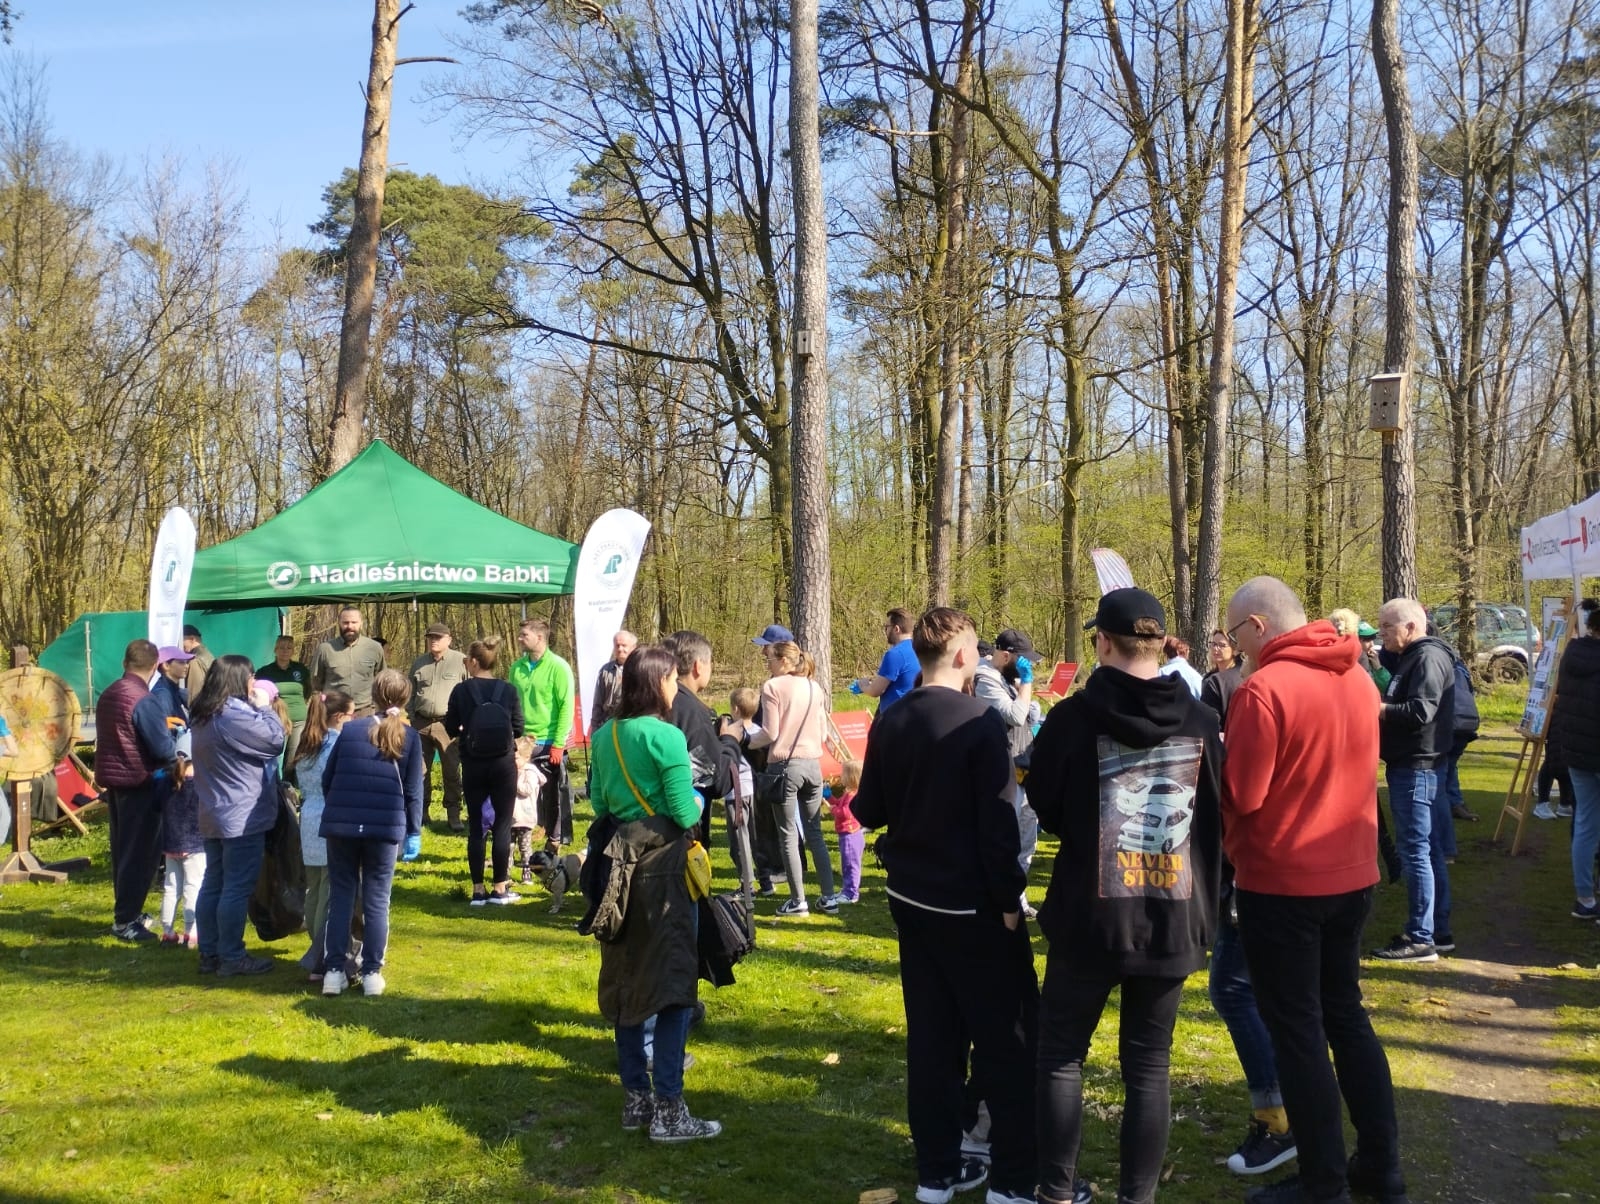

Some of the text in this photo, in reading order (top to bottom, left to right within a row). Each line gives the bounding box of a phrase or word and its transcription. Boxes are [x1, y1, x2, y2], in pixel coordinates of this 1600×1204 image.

[309, 561, 478, 584] Nadleśnictwo
[484, 564, 550, 584] Babki
[1116, 851, 1184, 871] NEVER
[1123, 869, 1178, 890] STOP
